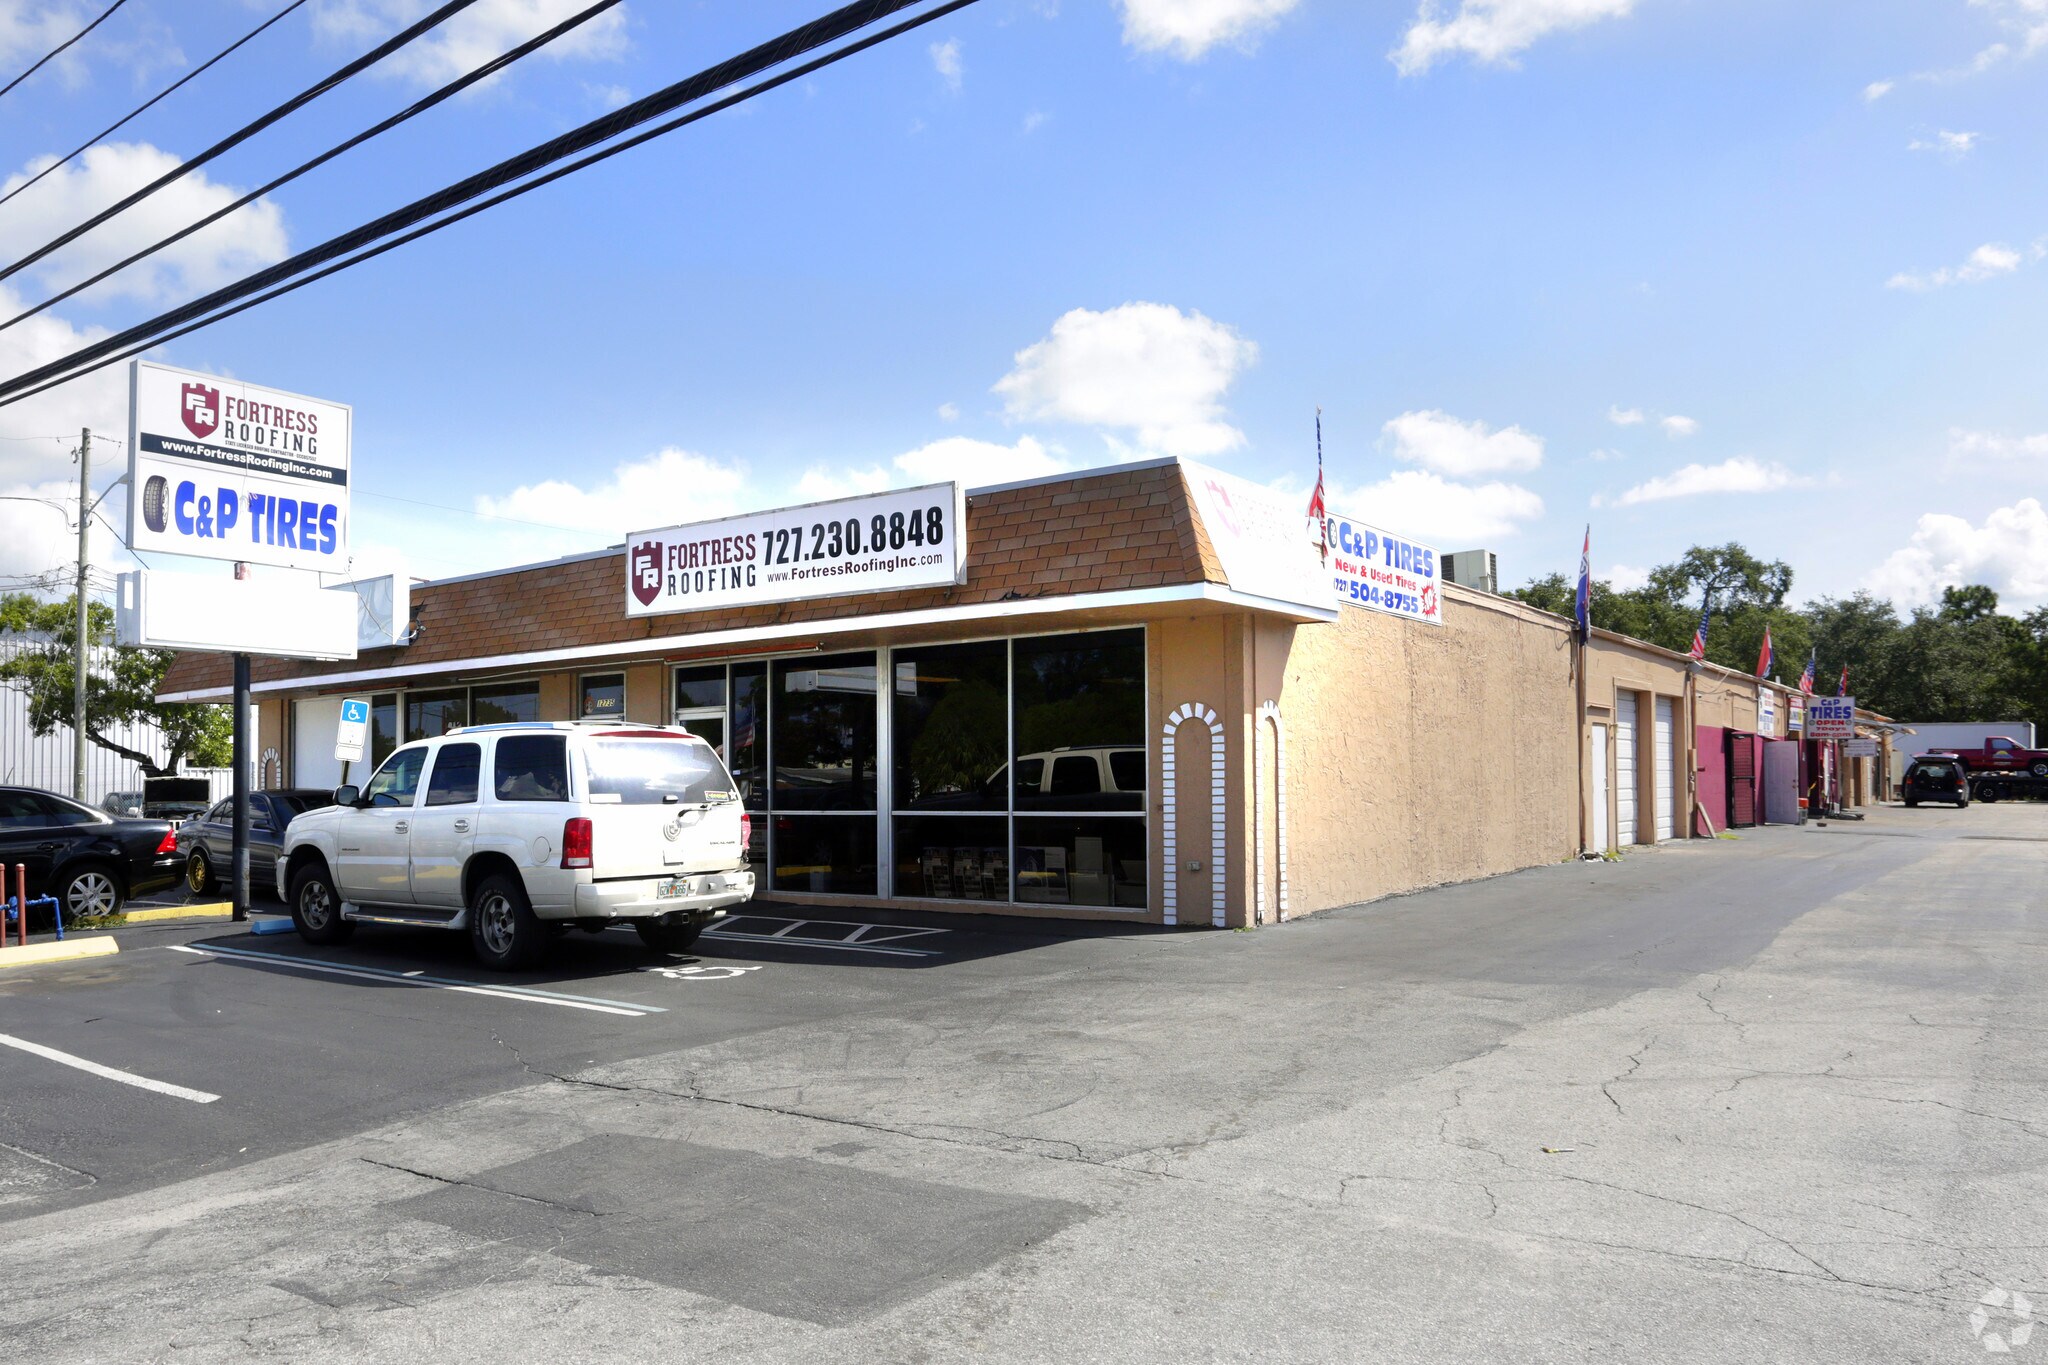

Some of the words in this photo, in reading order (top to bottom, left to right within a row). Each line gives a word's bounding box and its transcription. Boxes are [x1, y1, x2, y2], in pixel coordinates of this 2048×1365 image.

[225, 396, 317, 435] FORTRESS
[224, 420, 317, 455] ROOFING
[161, 438, 333, 479] www.FortressRoofingInc.com
[174, 480, 239, 539] C&P
[247, 491, 338, 555] TIRES
[667, 533, 756, 571] FORTRESS
[762, 506, 944, 566] 727.230.8848
[1339, 521, 1379, 560] C&P
[1383, 536, 1434, 578] TIRES
[667, 564, 756, 596] ROOFING
[767, 552, 943, 583] www.FortressRoofingInc.com
[1335, 558, 1357, 574] New
[1360, 565, 1367, 578] &
[1370, 568, 1393, 585] Used
[1395, 575, 1417, 591] Tires
[1350, 580, 1419, 613] 504-8755
[1810, 706, 1852, 719] TIRES
